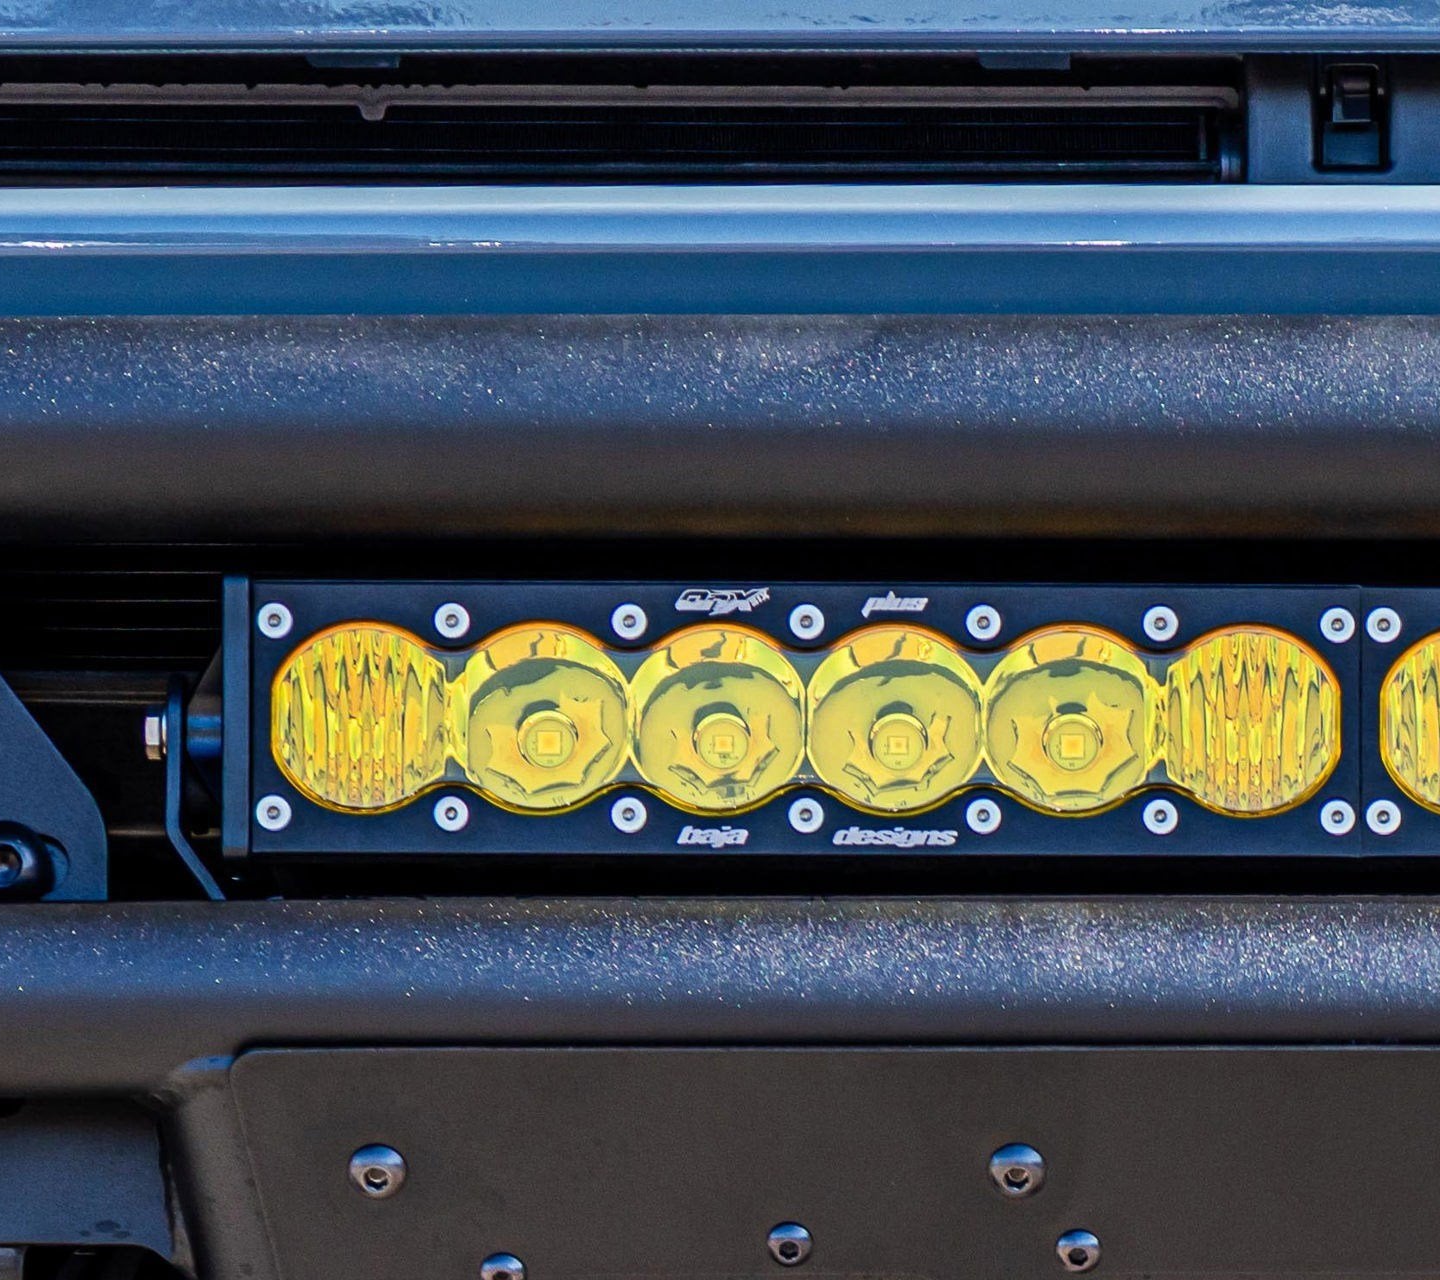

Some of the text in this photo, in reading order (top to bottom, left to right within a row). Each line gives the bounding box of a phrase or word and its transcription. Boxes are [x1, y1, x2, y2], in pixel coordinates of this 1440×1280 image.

[861, 590, 929, 618] plus
[677, 825, 958, 848] baja designs
